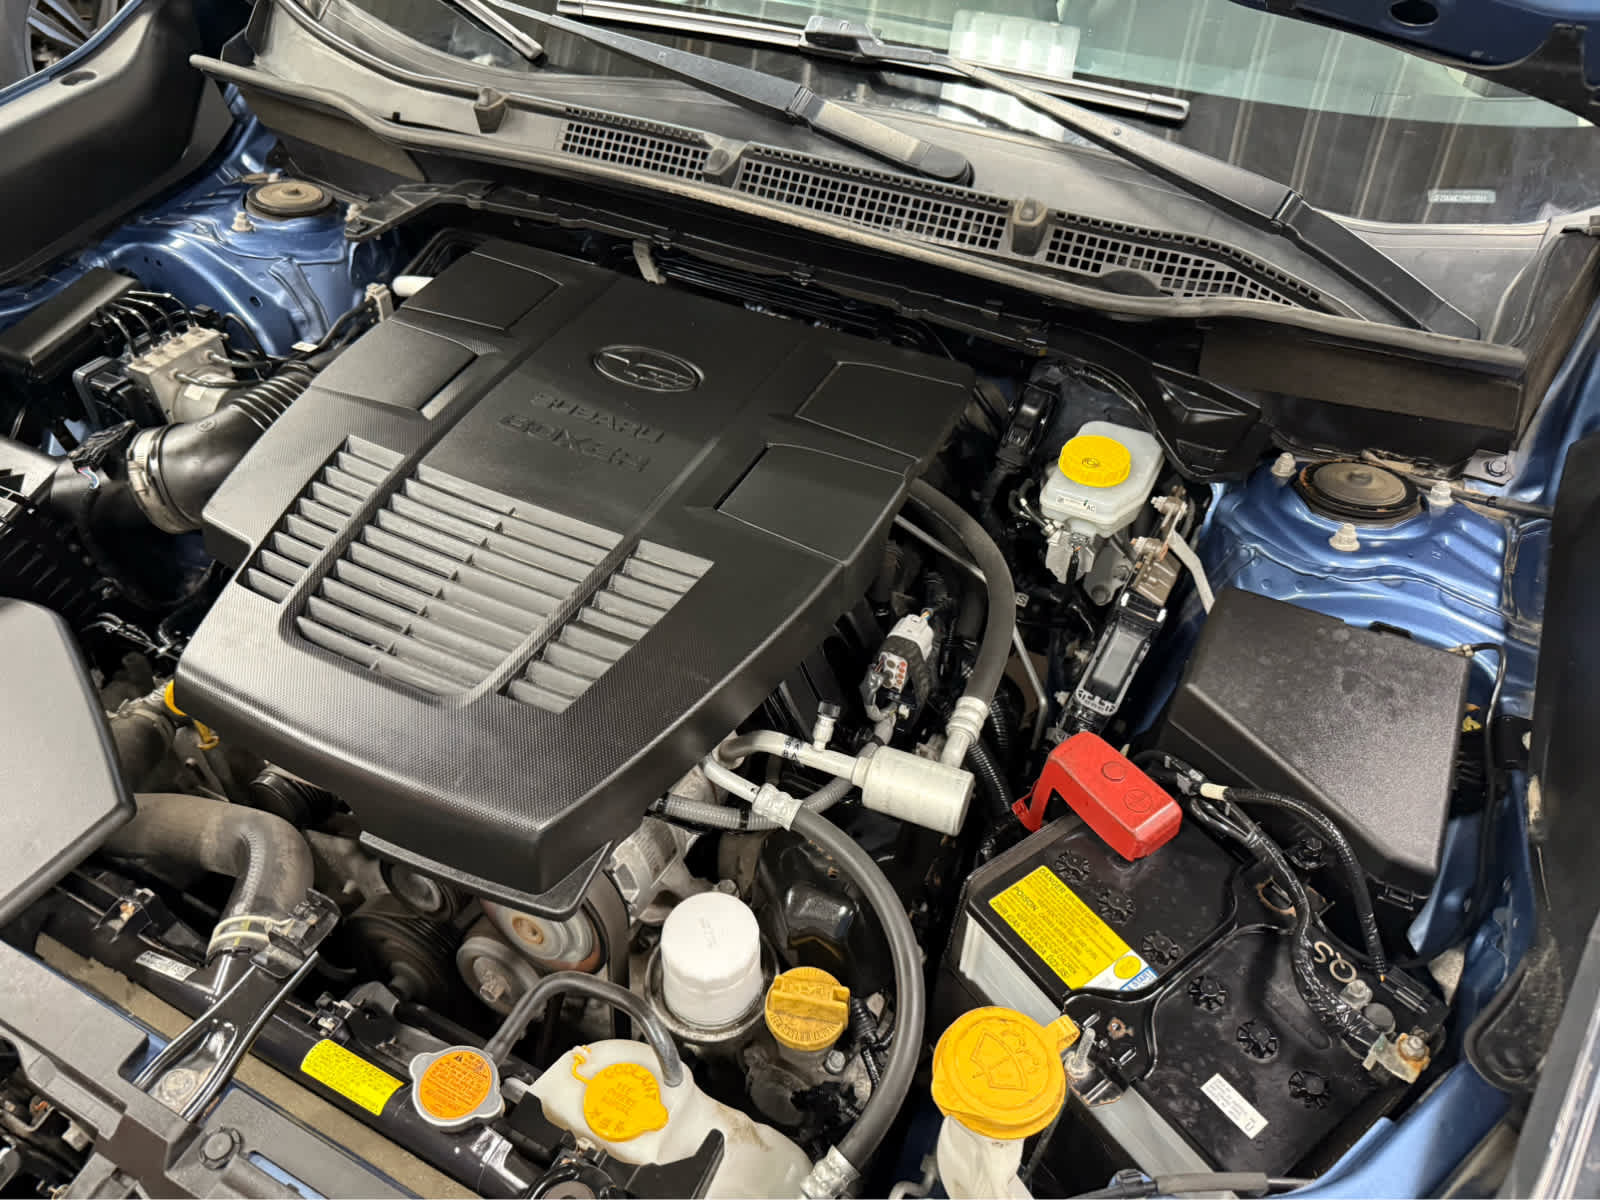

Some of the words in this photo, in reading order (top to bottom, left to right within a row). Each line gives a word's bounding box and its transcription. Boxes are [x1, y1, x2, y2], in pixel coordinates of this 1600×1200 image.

[530, 392, 665, 444] SUBARU
[497, 414, 651, 473] BOXER
[1011, 885, 1039, 911] POISON
[1038, 867, 1066, 894] DANGER
